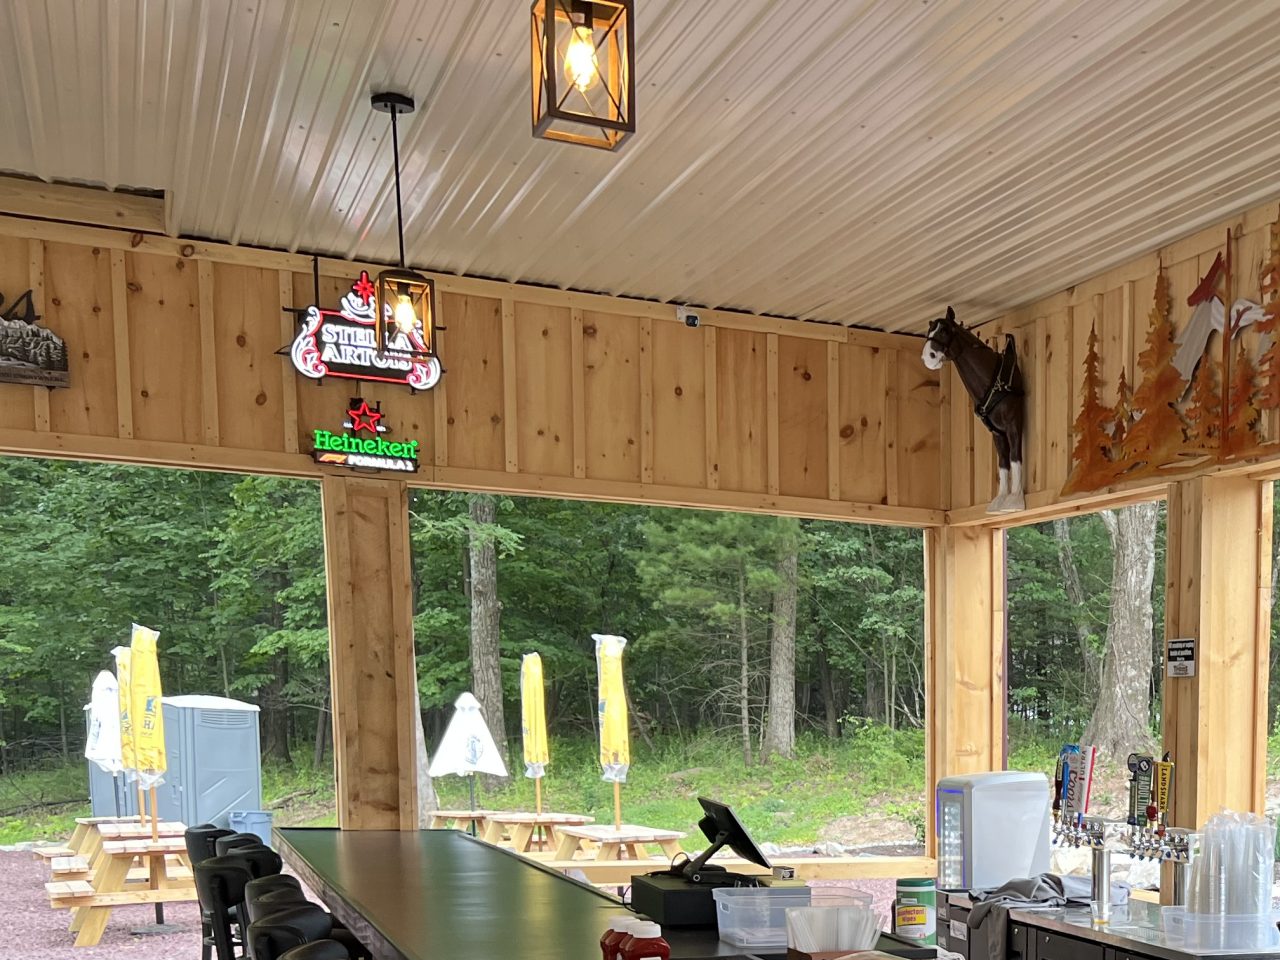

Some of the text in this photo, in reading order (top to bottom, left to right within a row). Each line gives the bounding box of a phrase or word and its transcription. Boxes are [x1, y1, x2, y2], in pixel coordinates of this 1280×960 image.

[321, 323, 412, 350] STELA
[314, 429, 417, 458] Heineken
[1067, 769, 1078, 808] Coors
[1160, 767, 1168, 810] LANDSHARK
